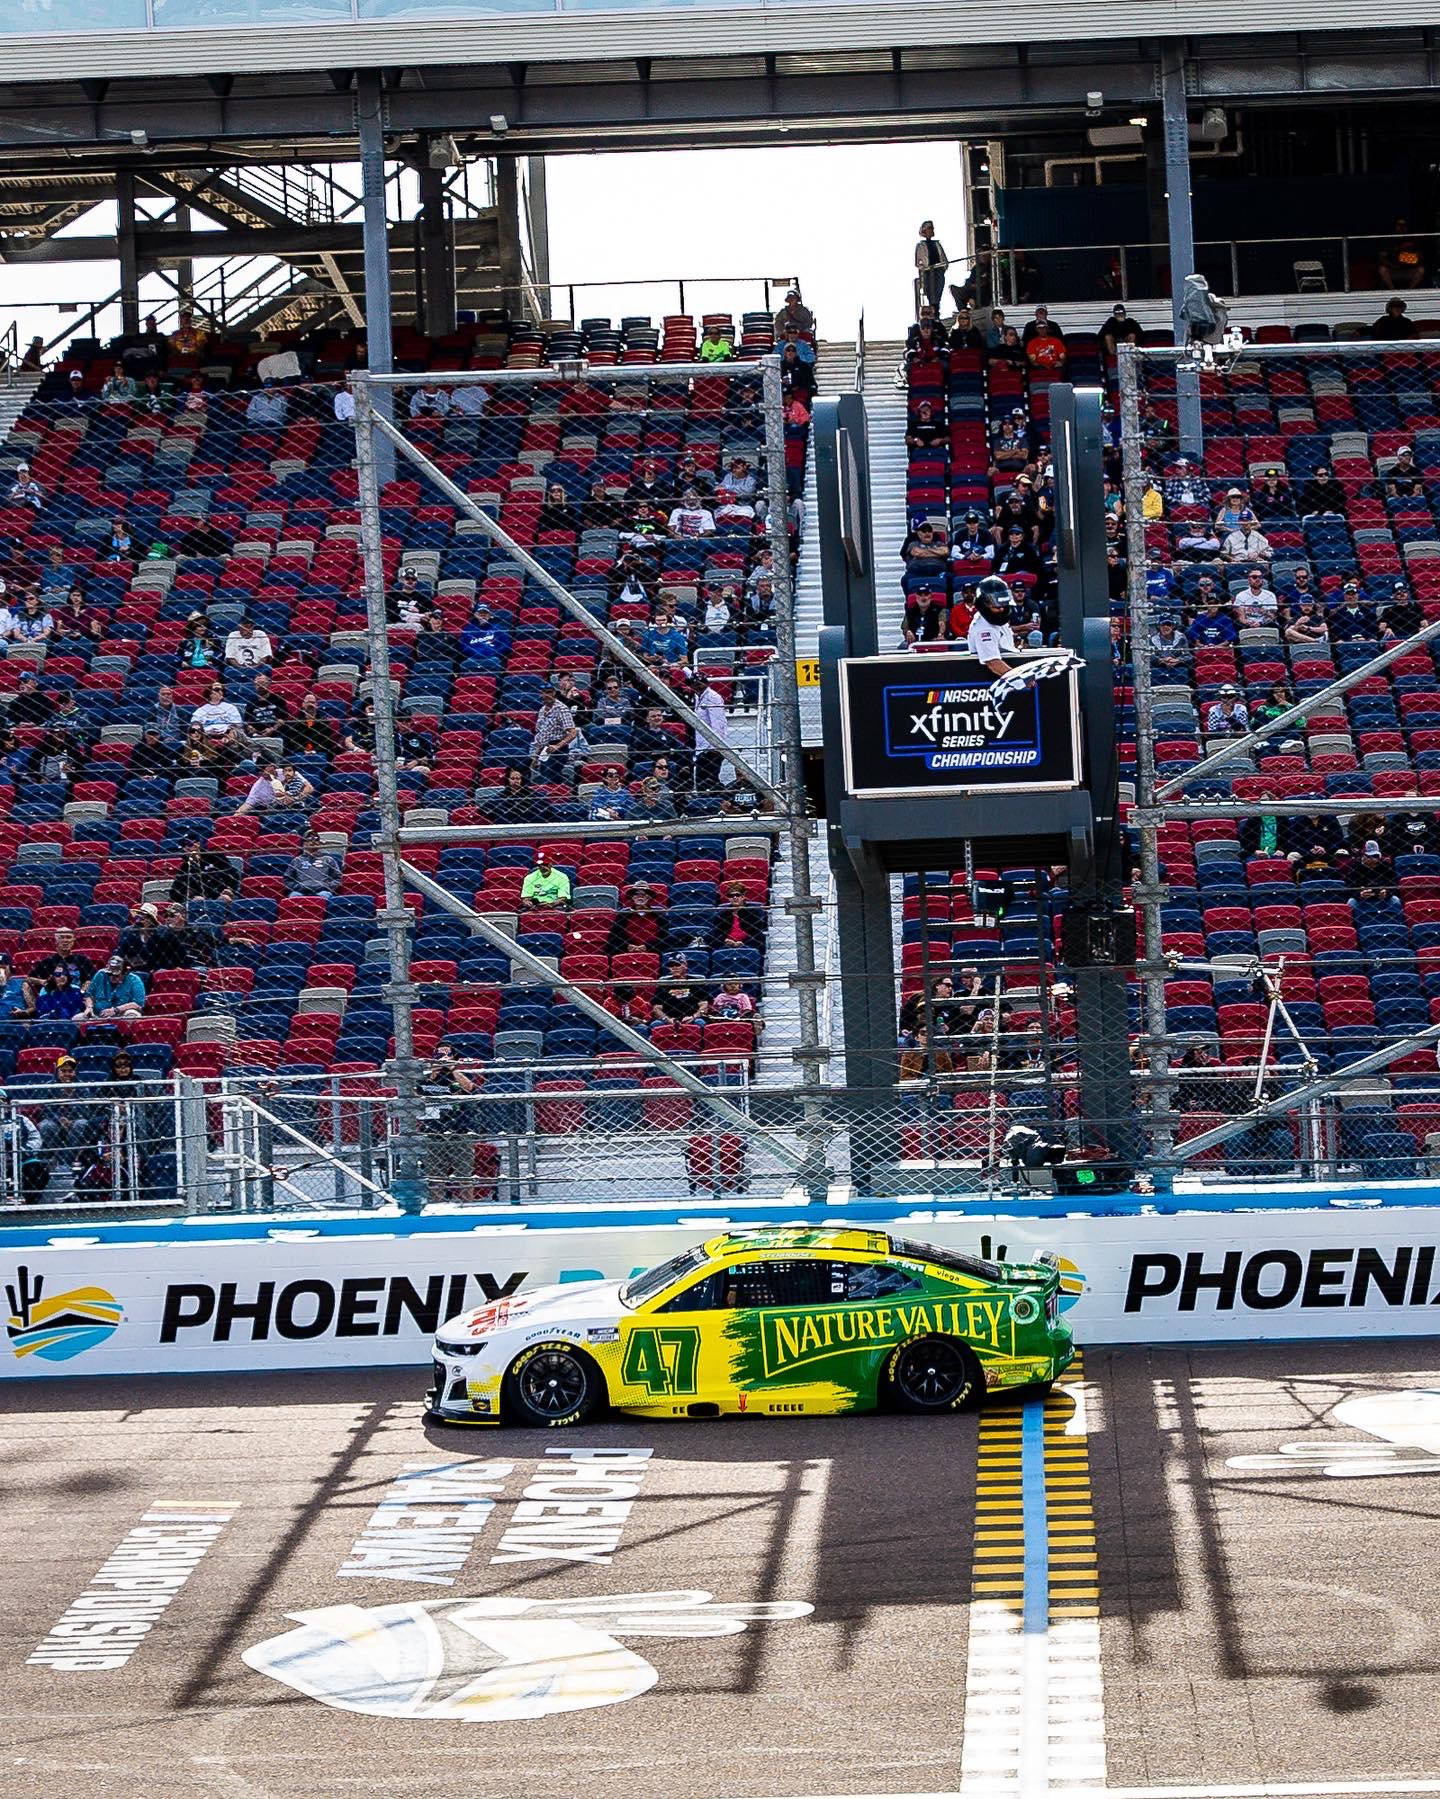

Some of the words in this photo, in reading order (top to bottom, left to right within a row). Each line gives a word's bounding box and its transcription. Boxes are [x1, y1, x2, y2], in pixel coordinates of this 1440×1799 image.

[910, 705, 1014, 742] xfinity
[942, 735, 985, 748] SERIES
[931, 751, 1037, 767] CHAMPIONSHIP
[1124, 1246, 1440, 1313] PHOENI
[621, 1326, 701, 1395] 47
[774, 1309, 895, 1365] NATURE
[896, 1301, 1004, 1348] VALLEY
[336, 1463, 515, 1586] RACEWAY
[489, 1447, 655, 1565] PHOENIX
[25, 1523, 224, 1672] CHAMPIONSHIP
